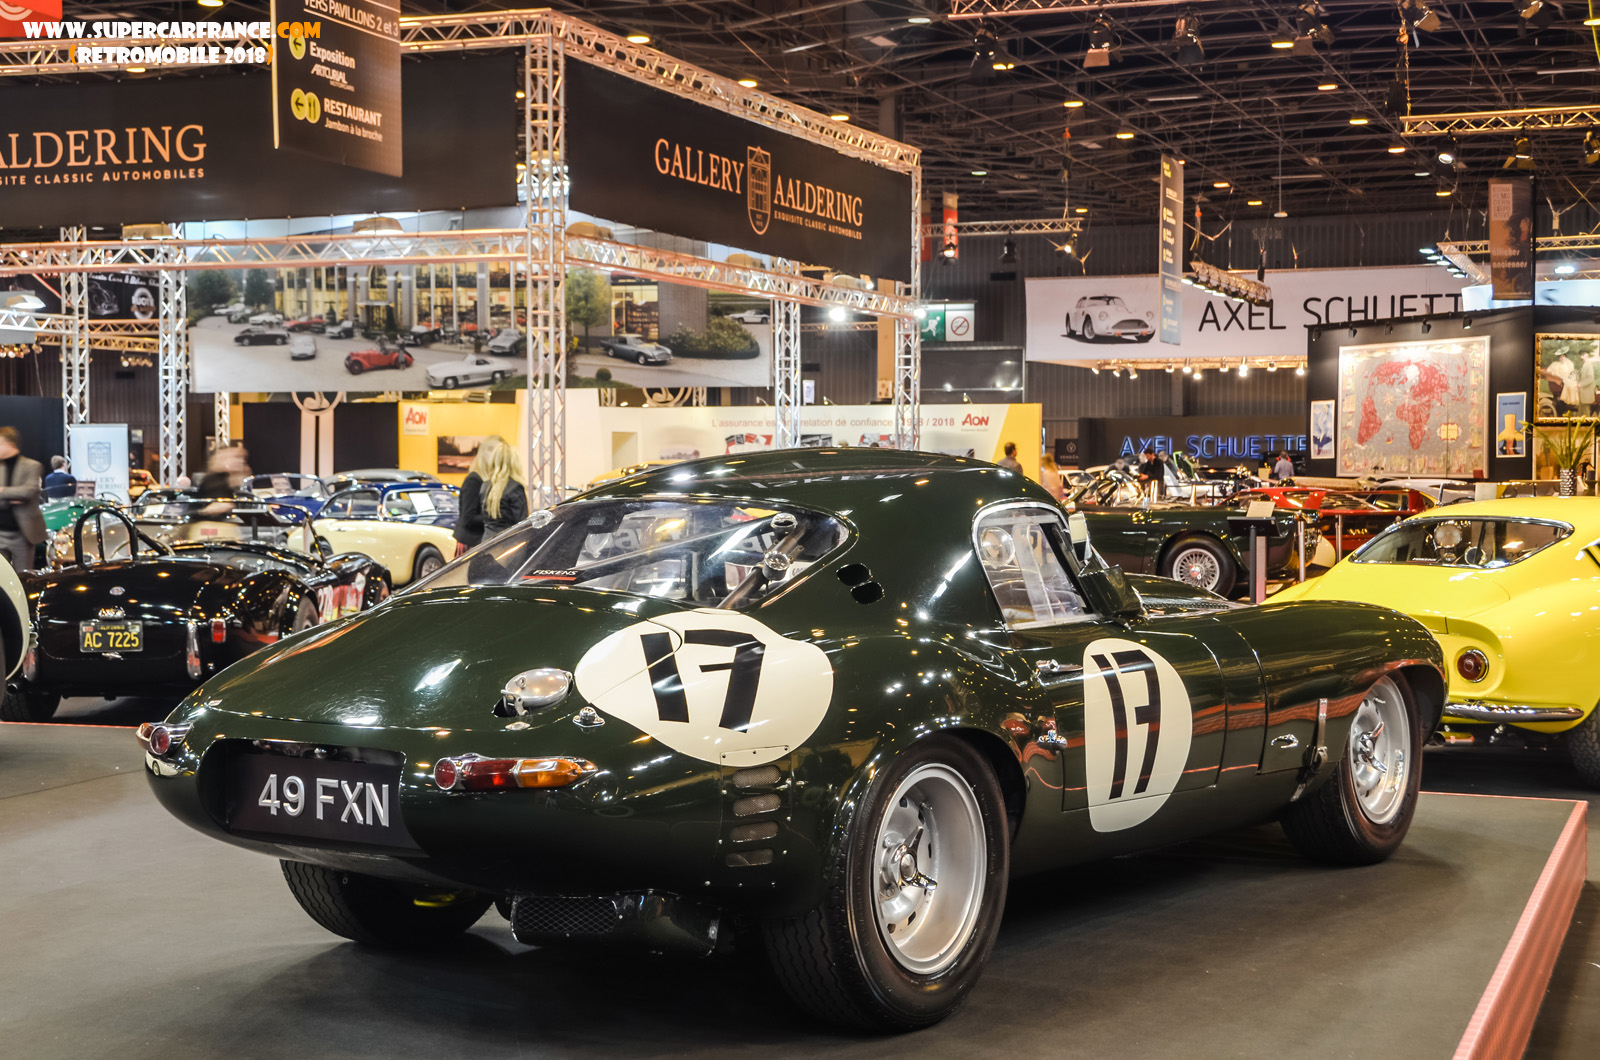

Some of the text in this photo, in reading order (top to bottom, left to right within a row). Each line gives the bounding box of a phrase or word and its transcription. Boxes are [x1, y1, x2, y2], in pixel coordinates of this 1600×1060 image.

[329, 1, 375, 29] PAVILLONS
[376, 17, 382, 31] 2
[383, 22, 393, 34] et
[393, 23, 399, 37] 3
[310, 41, 356, 69] Exposition
[324, 98, 382, 126] RESTAURANT
[324, 117, 350, 134] Jambon
[355, 124, 362, 137] la
[362, 127, 383, 142] broche
[34, 172, 94, 185] CLASSIC
[102, 168, 205, 182] AUTOMOBILES
[655, 138, 863, 227] GALLERY AALDERING
[774, 210, 803, 226] EXQUISITE
[805, 217, 826, 231] CLASSIC
[828, 224, 863, 240] AUTOMOBILES
[1198, 298, 1287, 333] AXEL
[1303, 293, 1462, 326] SCHUETT
[712, 418, 763, 428] L'assurance
[800, 417, 833, 428] relation
[835, 417, 847, 428] de
[850, 417, 893, 428] confiance
[932, 418, 955, 427] 2018
[84, 631, 140, 648] AC 7225
[640, 628, 766, 734] 17
[1090, 649, 1162, 800] 17
[258, 773, 390, 828] 49 FXN
